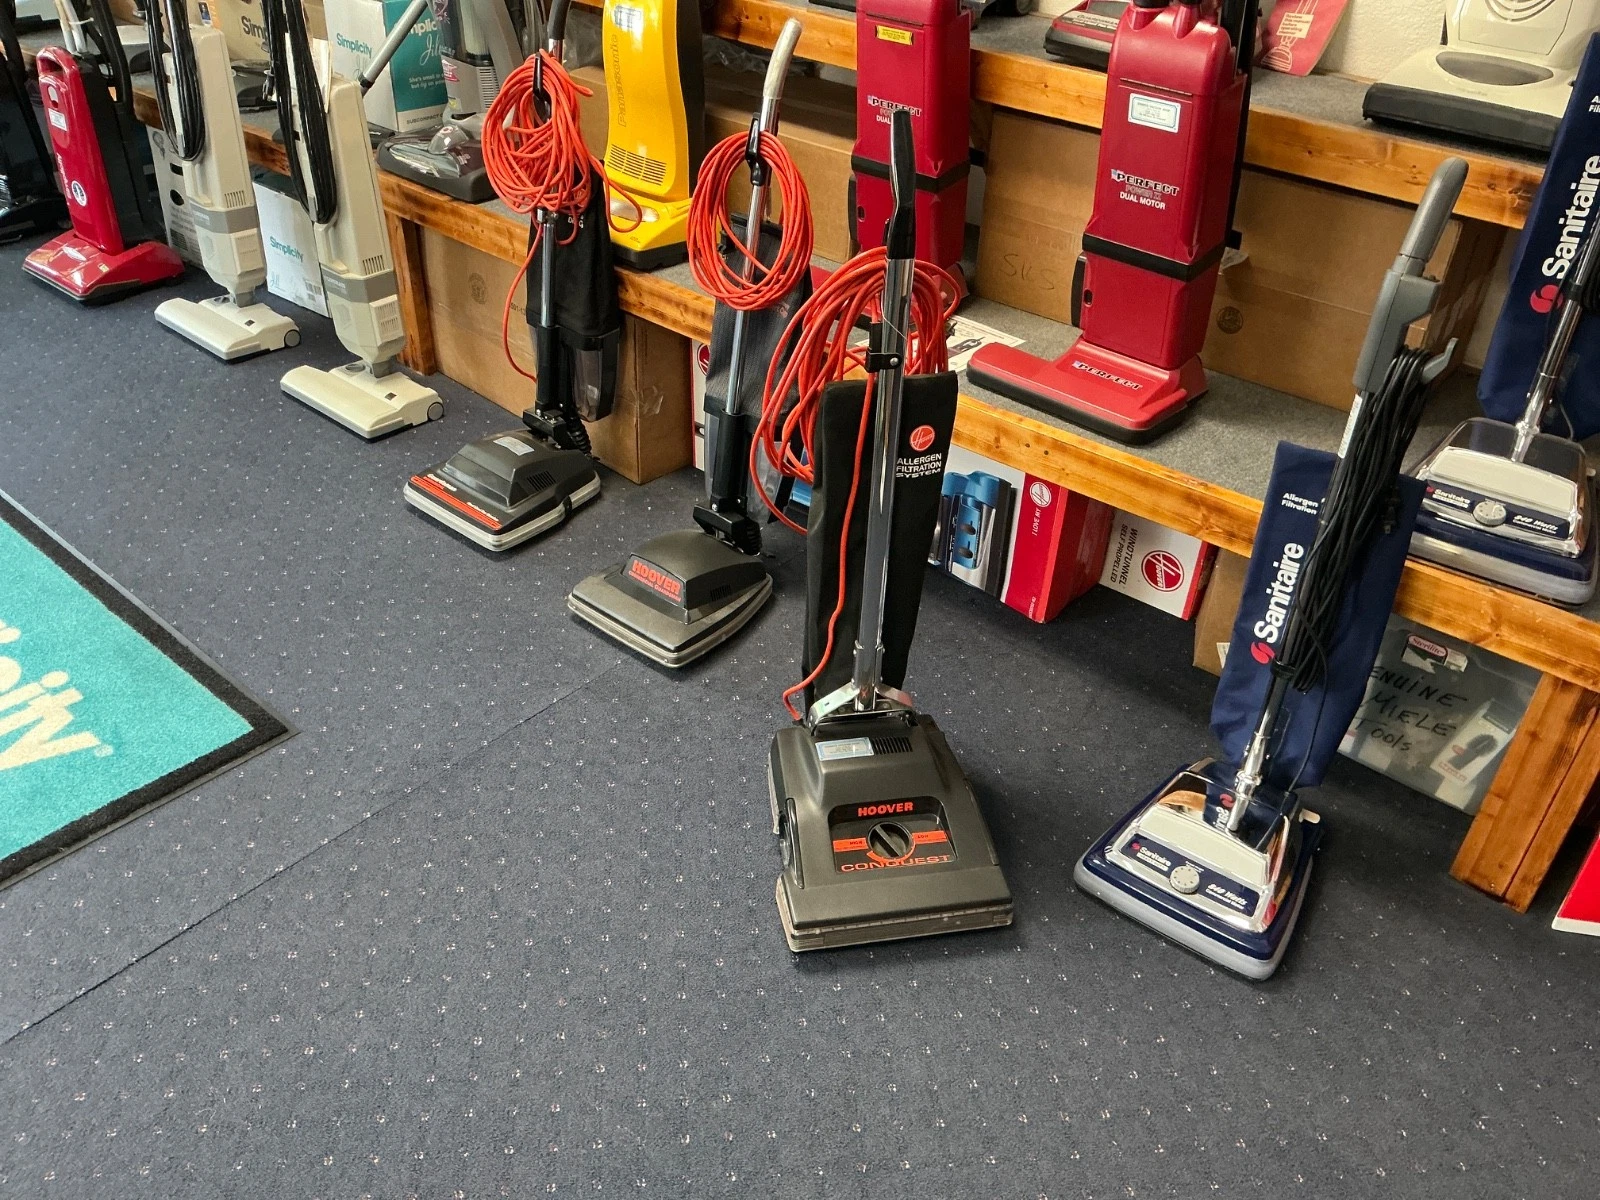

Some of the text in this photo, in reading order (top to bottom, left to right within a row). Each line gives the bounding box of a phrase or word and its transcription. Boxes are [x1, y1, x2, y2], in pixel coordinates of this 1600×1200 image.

[336, 32, 372, 58] Simplicity
[876, 115, 892, 125] DUAL
[1116, 171, 1180, 196] PERFECT
[1120, 191, 1166, 210] DUAL MOTOR
[1541, 154, 1600, 280] Sanitaire
[270, 235, 304, 263] Simplicity
[1078, 362, 1144, 390] PERFECT
[896, 452, 942, 466] ALLERGEN
[896, 461, 942, 473] FILTRATION
[895, 468, 941, 479] SYSTEM
[1282, 492, 1318, 508] Allergen
[1434, 489, 1471, 504] Sanitaire
[1281, 500, 1318, 515] Filtration
[1110, 524, 1128, 583] SELF PROPELLED
[1119, 528, 1139, 586] WINDTUNNEL
[632, 560, 681, 595] HOOVER
[1253, 542, 1304, 644] Sanitaire
[1411, 636, 1444, 657] Sterilite
[858, 801, 914, 817] HOOVER
[840, 854, 950, 872] CONQUEST
[1140, 846, 1172, 867] Sanitaire
